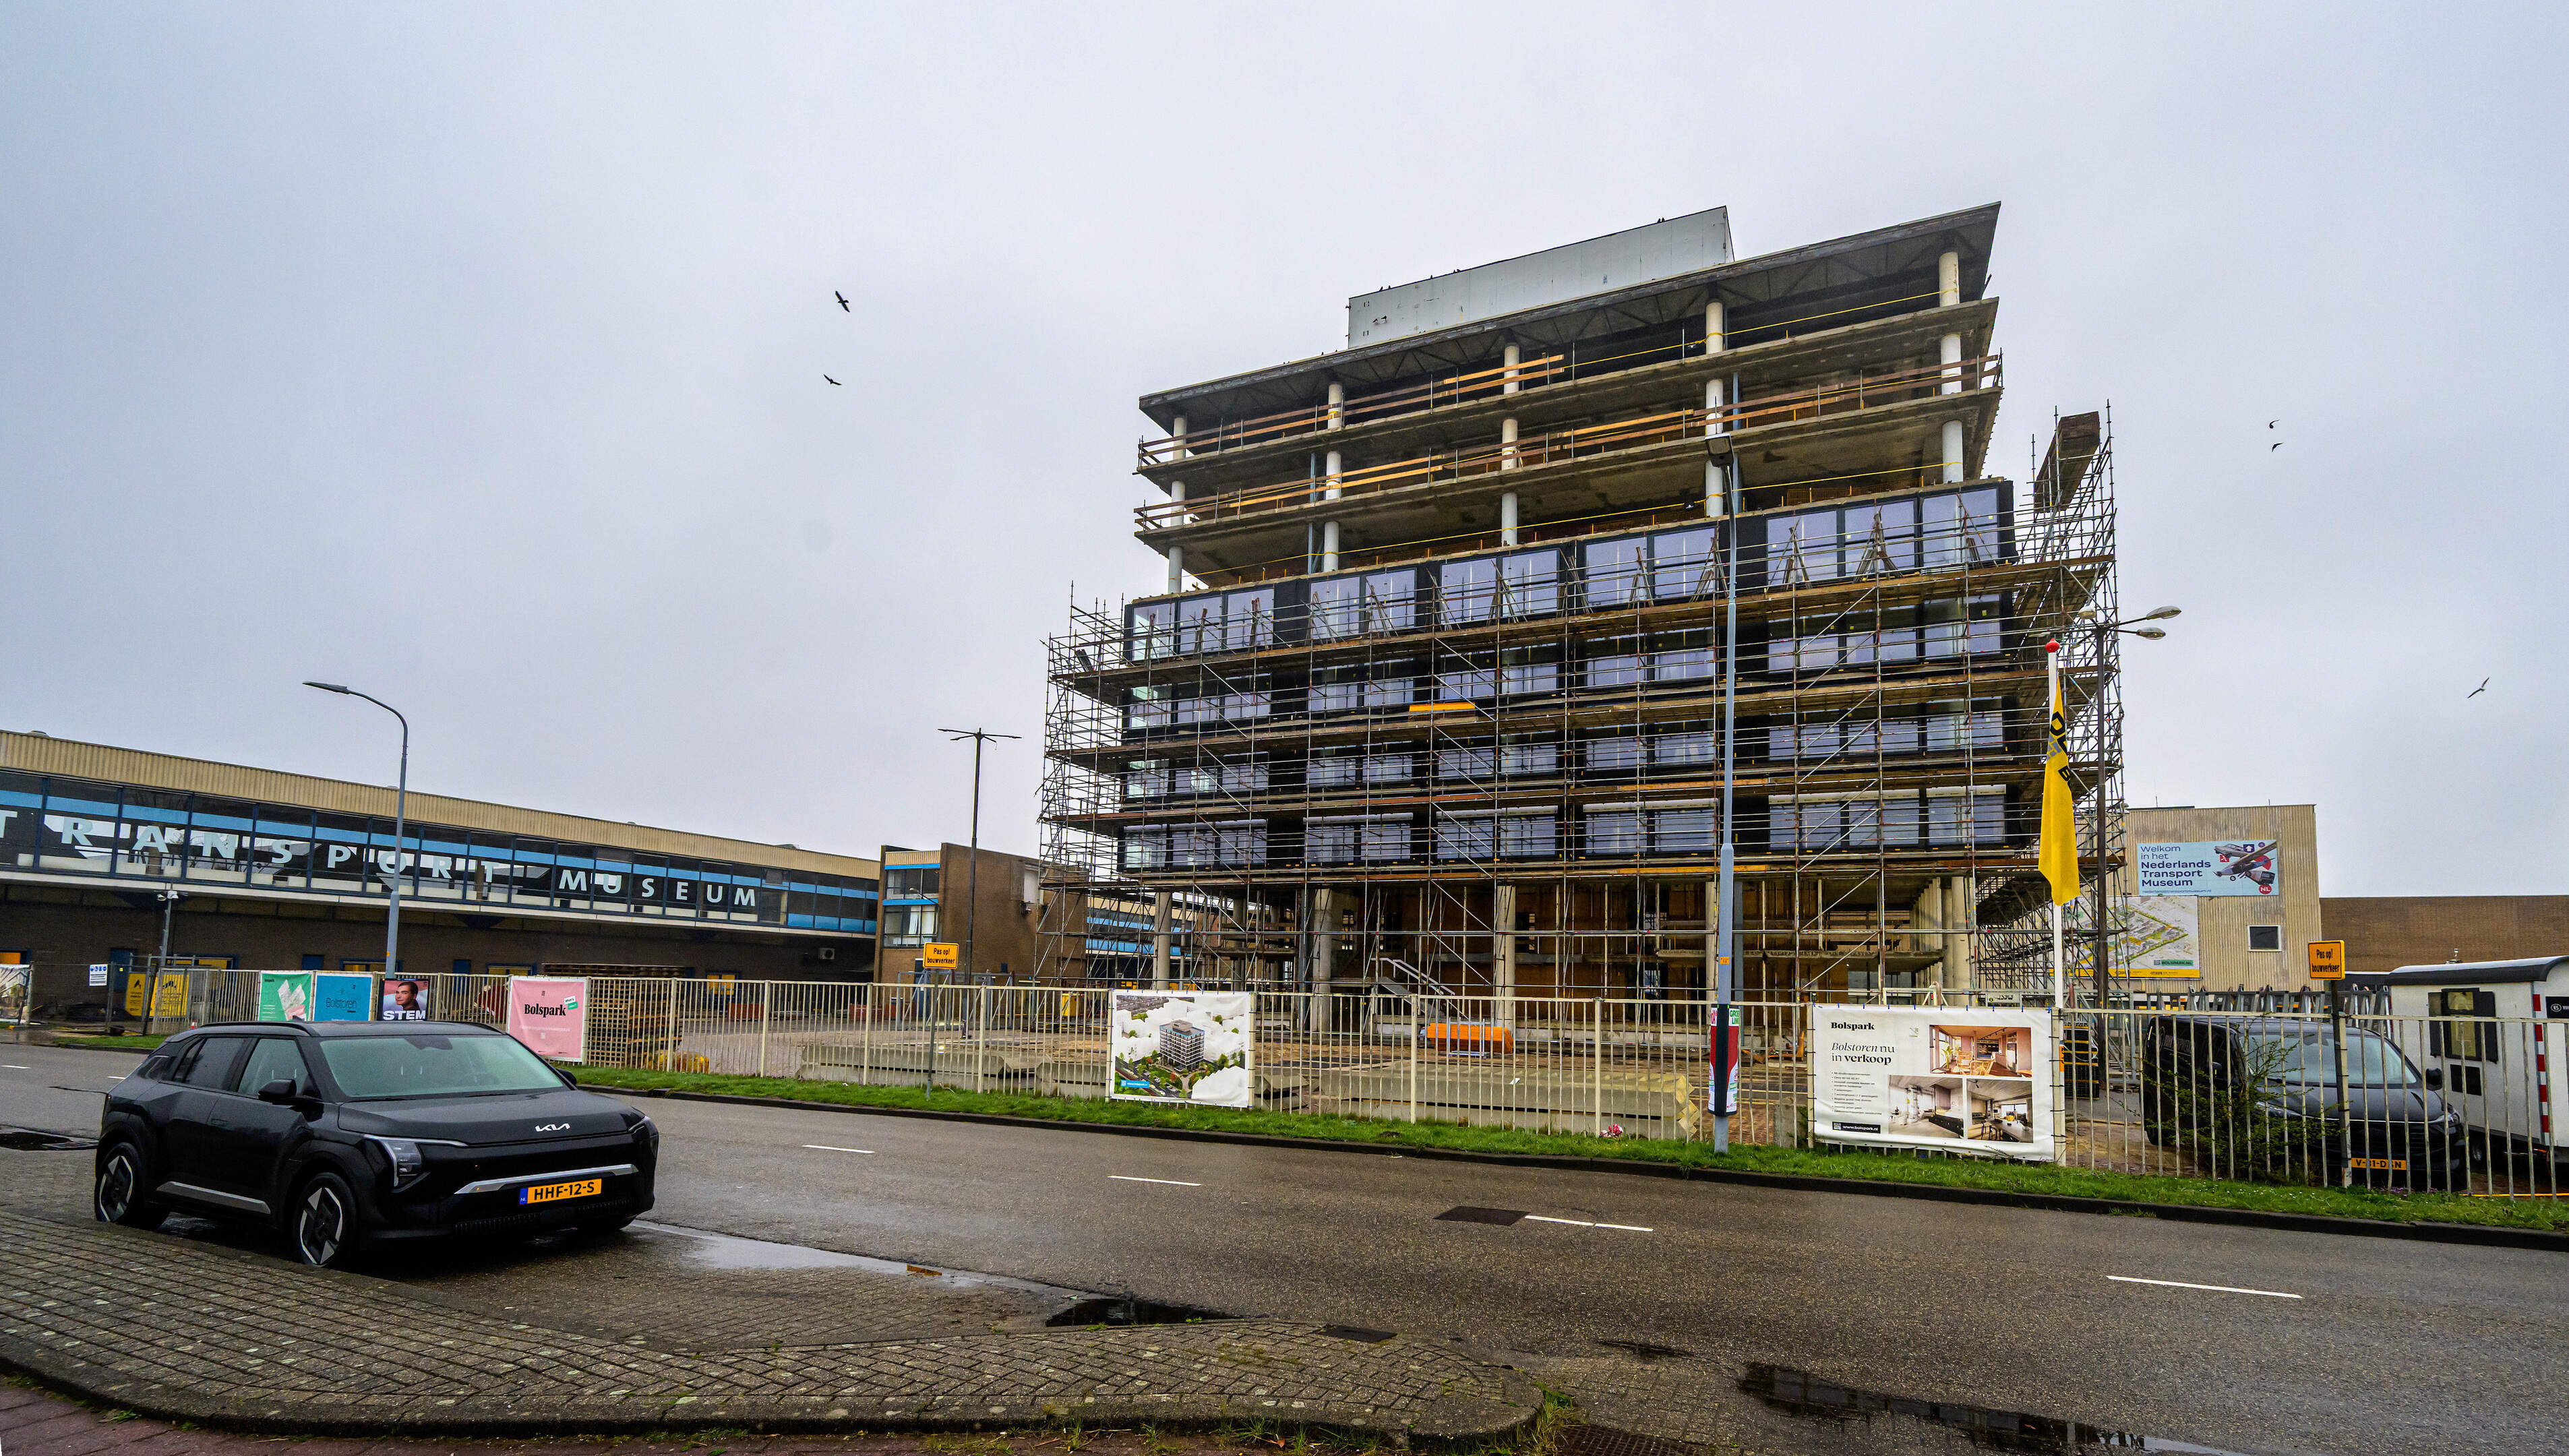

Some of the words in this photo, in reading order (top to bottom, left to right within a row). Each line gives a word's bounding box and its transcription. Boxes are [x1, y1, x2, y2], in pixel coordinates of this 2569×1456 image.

[2141, 860, 2211, 869] Nederlands
[2142, 870, 2203, 878] Transport
[559, 869, 756, 907] MUSEUM
[2316, 949, 2325, 959] Pas
[2311, 963, 2340, 972] bouwverkeer
[383, 1010, 426, 1021] STEM
[524, 1003, 566, 1018] Bolspark
[1831, 1022, 1875, 1031] Bolspark
[1832, 1042, 1878, 1052] Bolstoren
[1832, 1053, 1842, 1062] in
[1844, 1054, 1892, 1065] verkoop
[535, 1123, 571, 1132] KIA
[2355, 1159, 2401, 1169] V-1-DN
[534, 1181, 595, 1201] HHF-12-S
